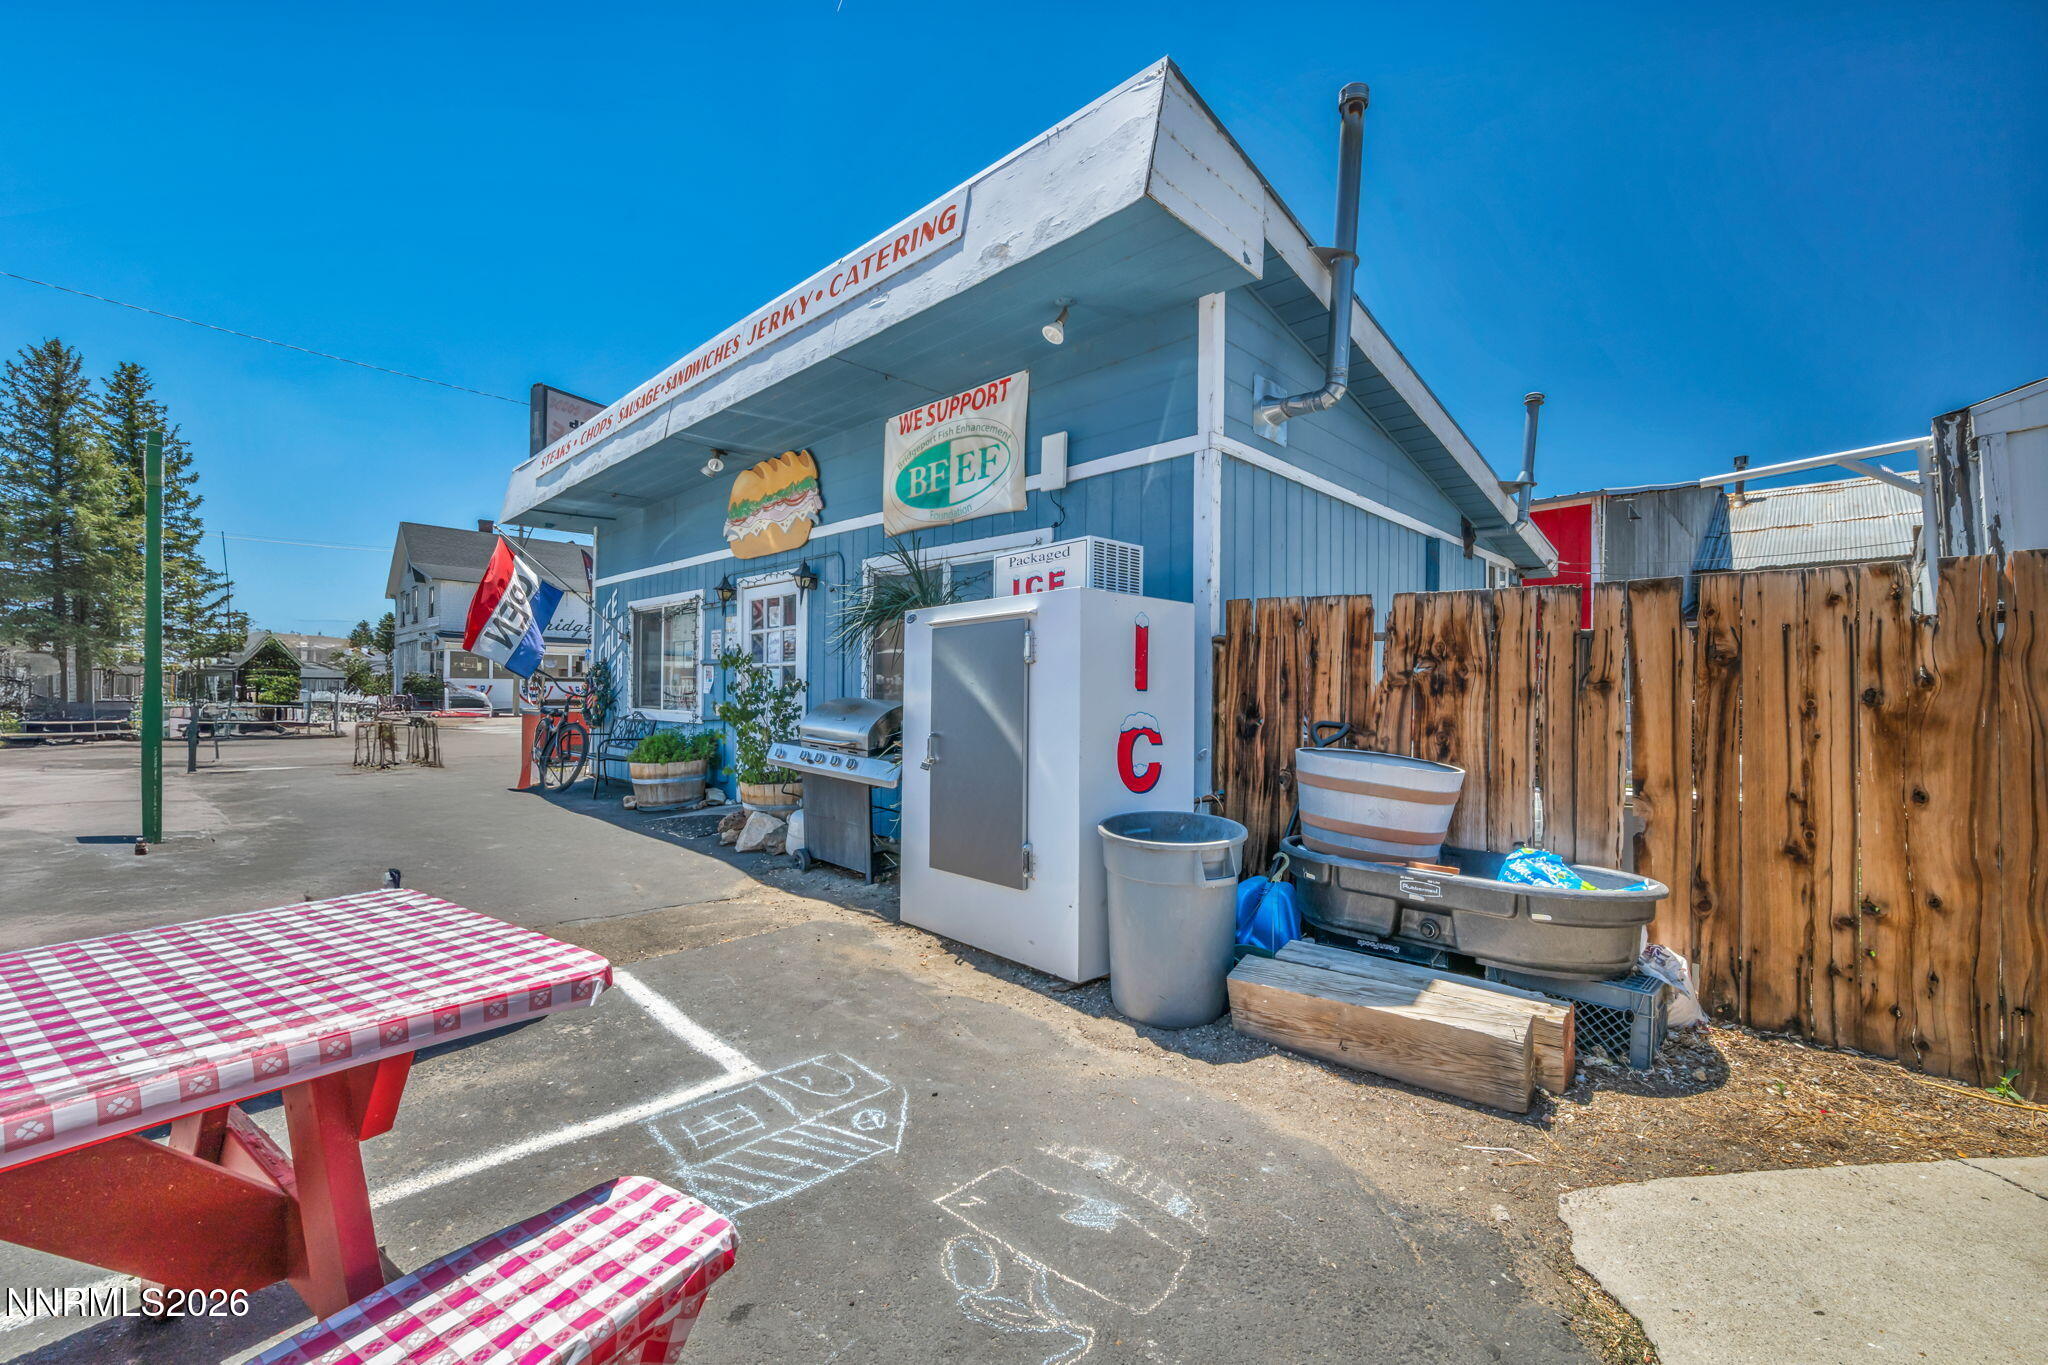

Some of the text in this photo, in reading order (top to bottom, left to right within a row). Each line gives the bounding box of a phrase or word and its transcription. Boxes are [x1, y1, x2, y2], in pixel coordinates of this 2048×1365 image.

[540, 204, 958, 470] STEAKS CHOPS SAUSAGE SANDWICHES JERKY CATERING
[899, 377, 1012, 436] WE SUPPORT
[938, 427, 954, 440] Fish
[956, 422, 1012, 442] Enhancement
[907, 443, 1000, 499] BEEF
[929, 504, 972, 521] Foundation
[1008, 546, 1071, 568] Packaged
